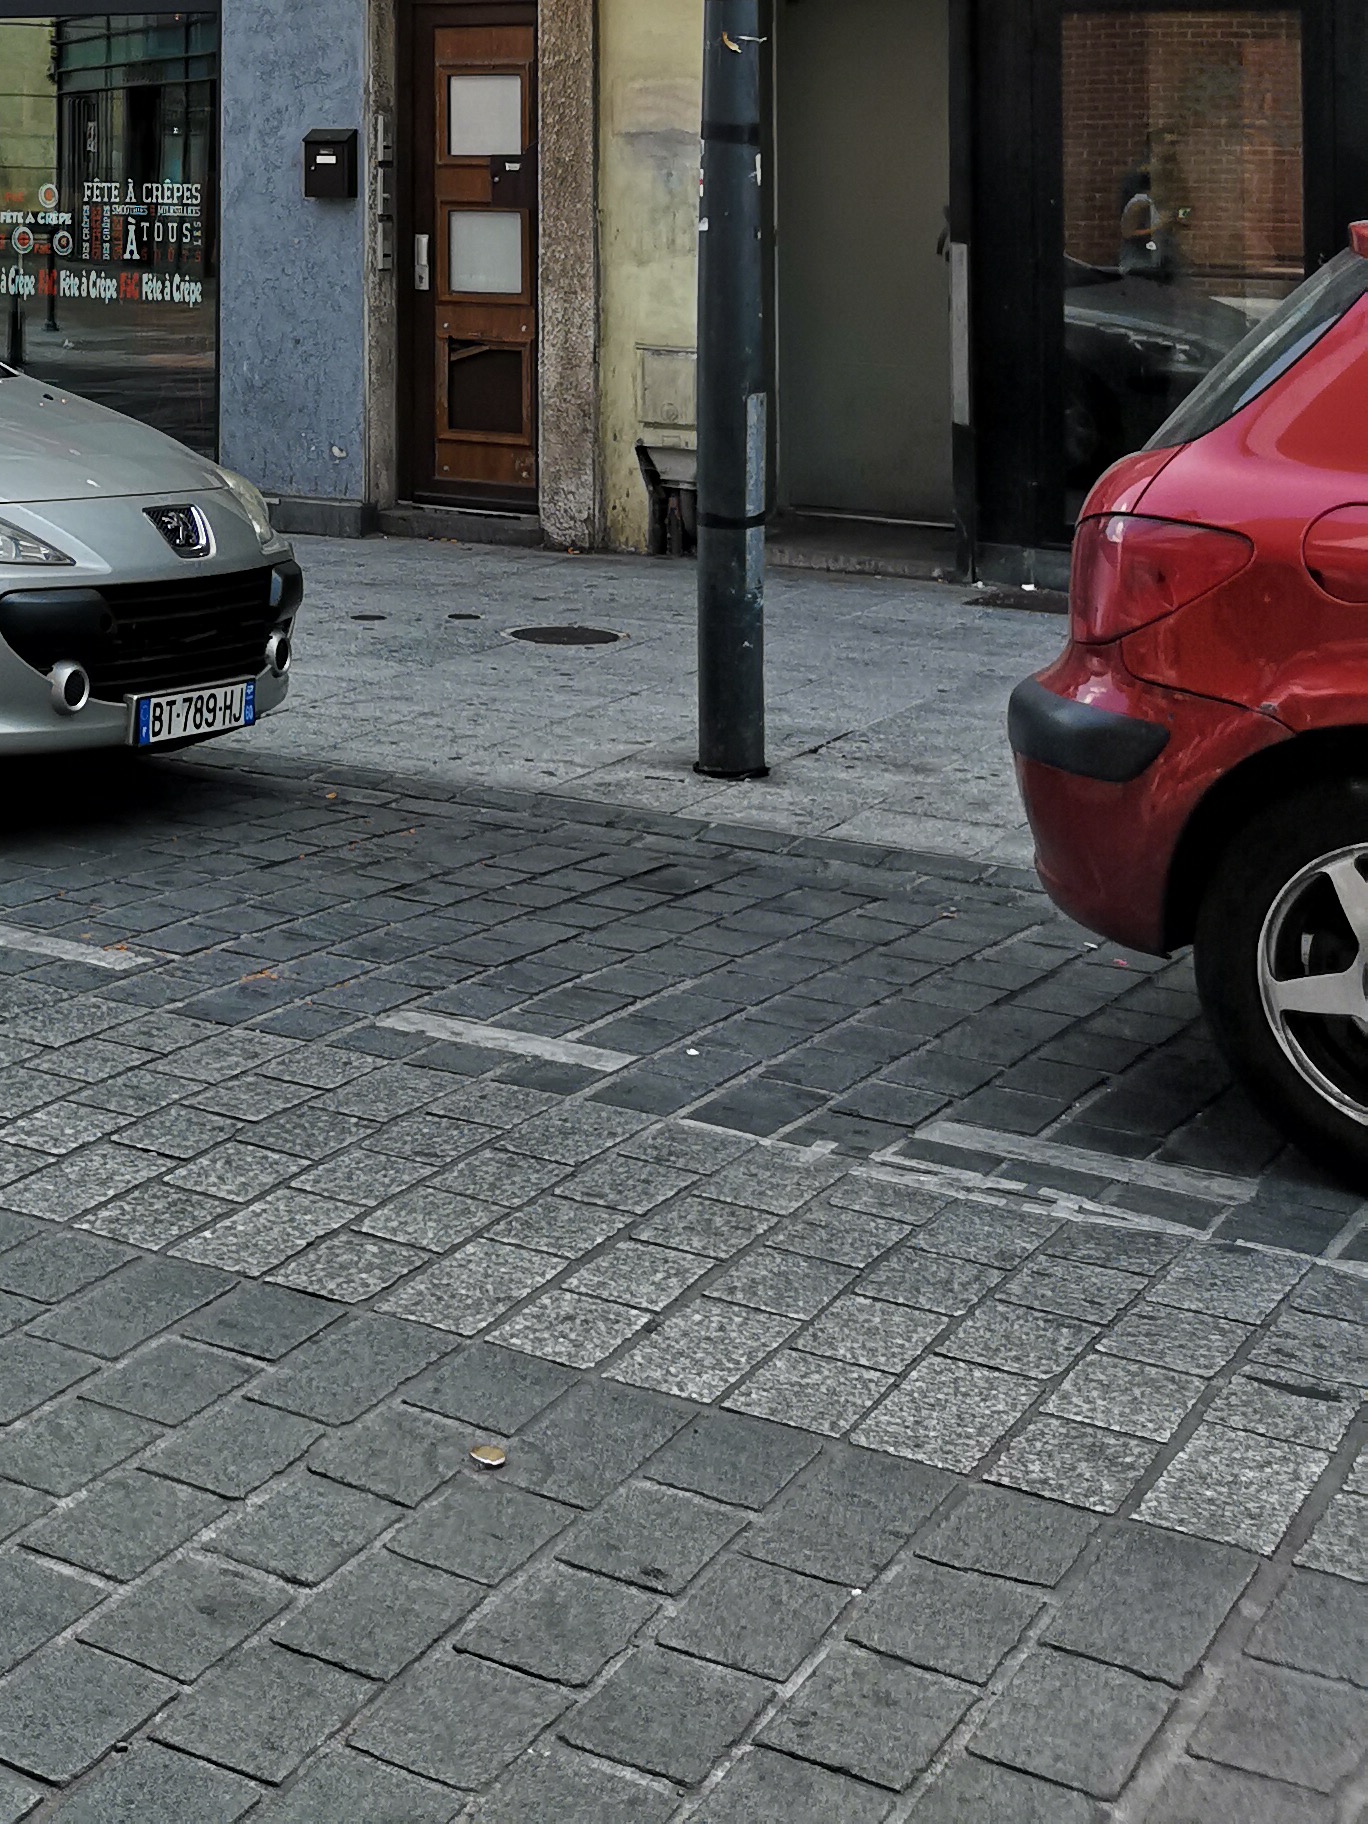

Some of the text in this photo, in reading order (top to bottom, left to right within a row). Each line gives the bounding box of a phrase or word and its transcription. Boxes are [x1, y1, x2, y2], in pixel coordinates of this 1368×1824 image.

[82, 177, 202, 204] FÊTE À CRÊPES
[0, 209, 24, 224] FÊTE
[37, 209, 72, 225] CRÊPE
[111, 204, 149, 216] SMOOTHIES
[157, 205, 202, 217] MILKSHAKES
[123, 216, 192, 260] À TOUS
[8, 265, 36, 301] Crêpe
[59, 269, 80, 297] Fête
[89, 270, 118, 304] Crêpe
[142, 272, 163, 301] Fête
[172, 273, 203, 308] Crêpe
